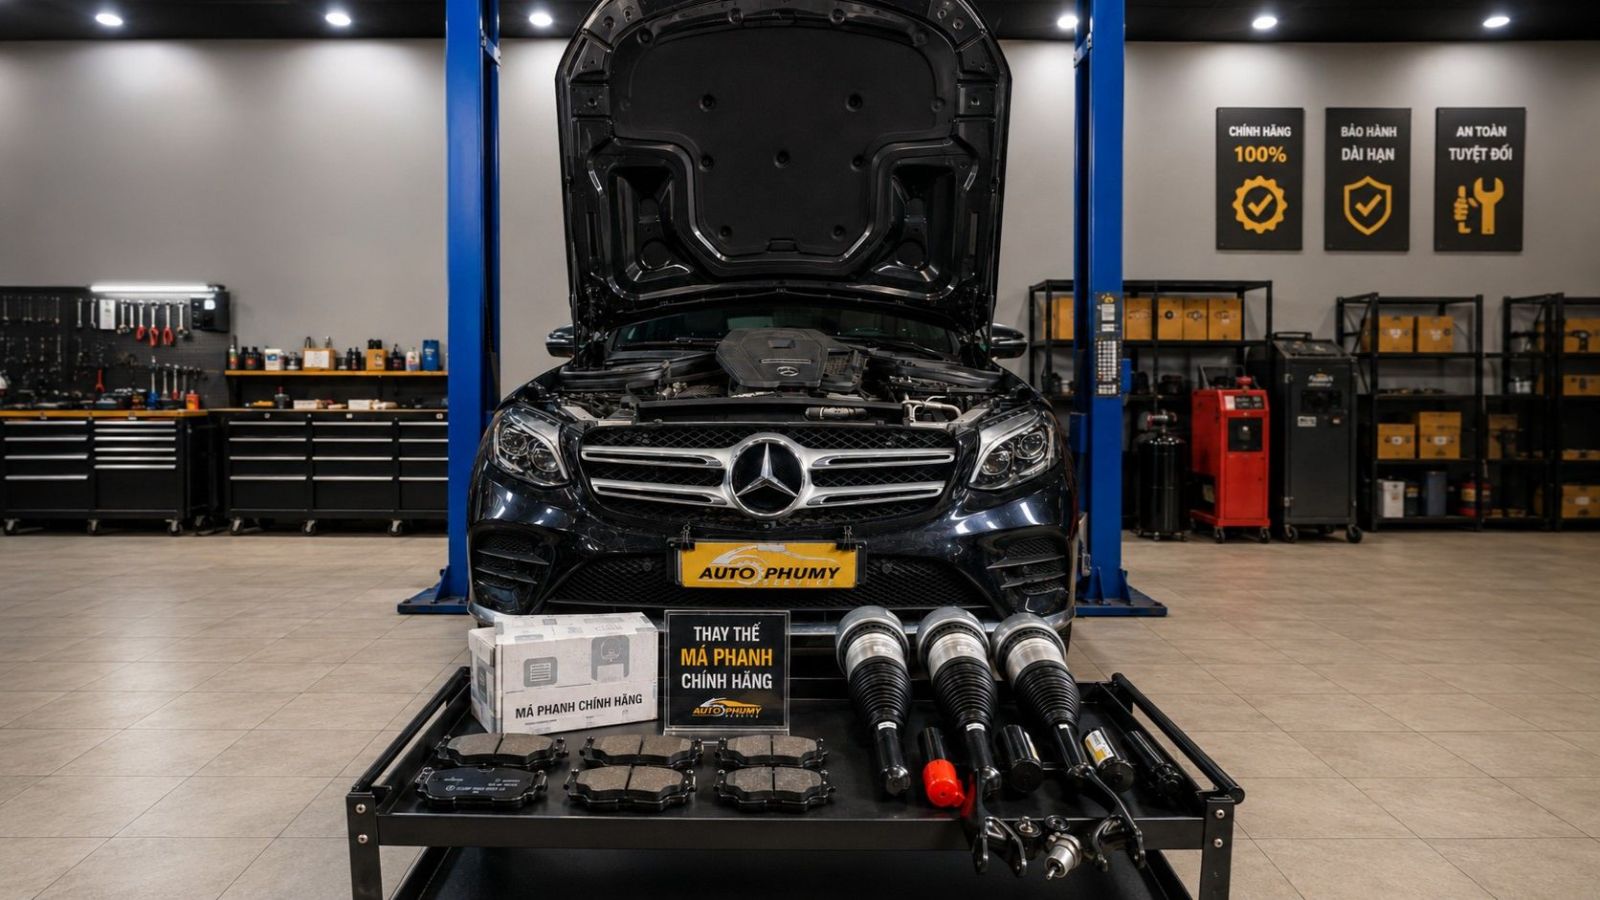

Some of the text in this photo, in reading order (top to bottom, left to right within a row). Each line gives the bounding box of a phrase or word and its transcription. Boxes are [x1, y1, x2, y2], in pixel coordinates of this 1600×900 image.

[1229, 123, 1260, 137] CHÍNH
[1366, 123, 1397, 137] HÀNH
[1456, 123, 1507, 137] AN TOÀN
[1234, 145, 1287, 163] 100%
[1342, 145, 1395, 164] DÀI HẠN
[1448, 143, 1513, 164] TUYỆT ĐỐI
[699, 567, 841, 580] AUTO PHUMY
[693, 621, 761, 641] THAY THẾ
[681, 644, 773, 666] MÁ PHANH
[681, 669, 727, 689] CHÍNH
[515, 704, 534, 719] MÁ
[537, 701, 576, 716] PHANH
[578, 696, 612, 711] CHÍNH
[725, 707, 762, 715] PHUMY
